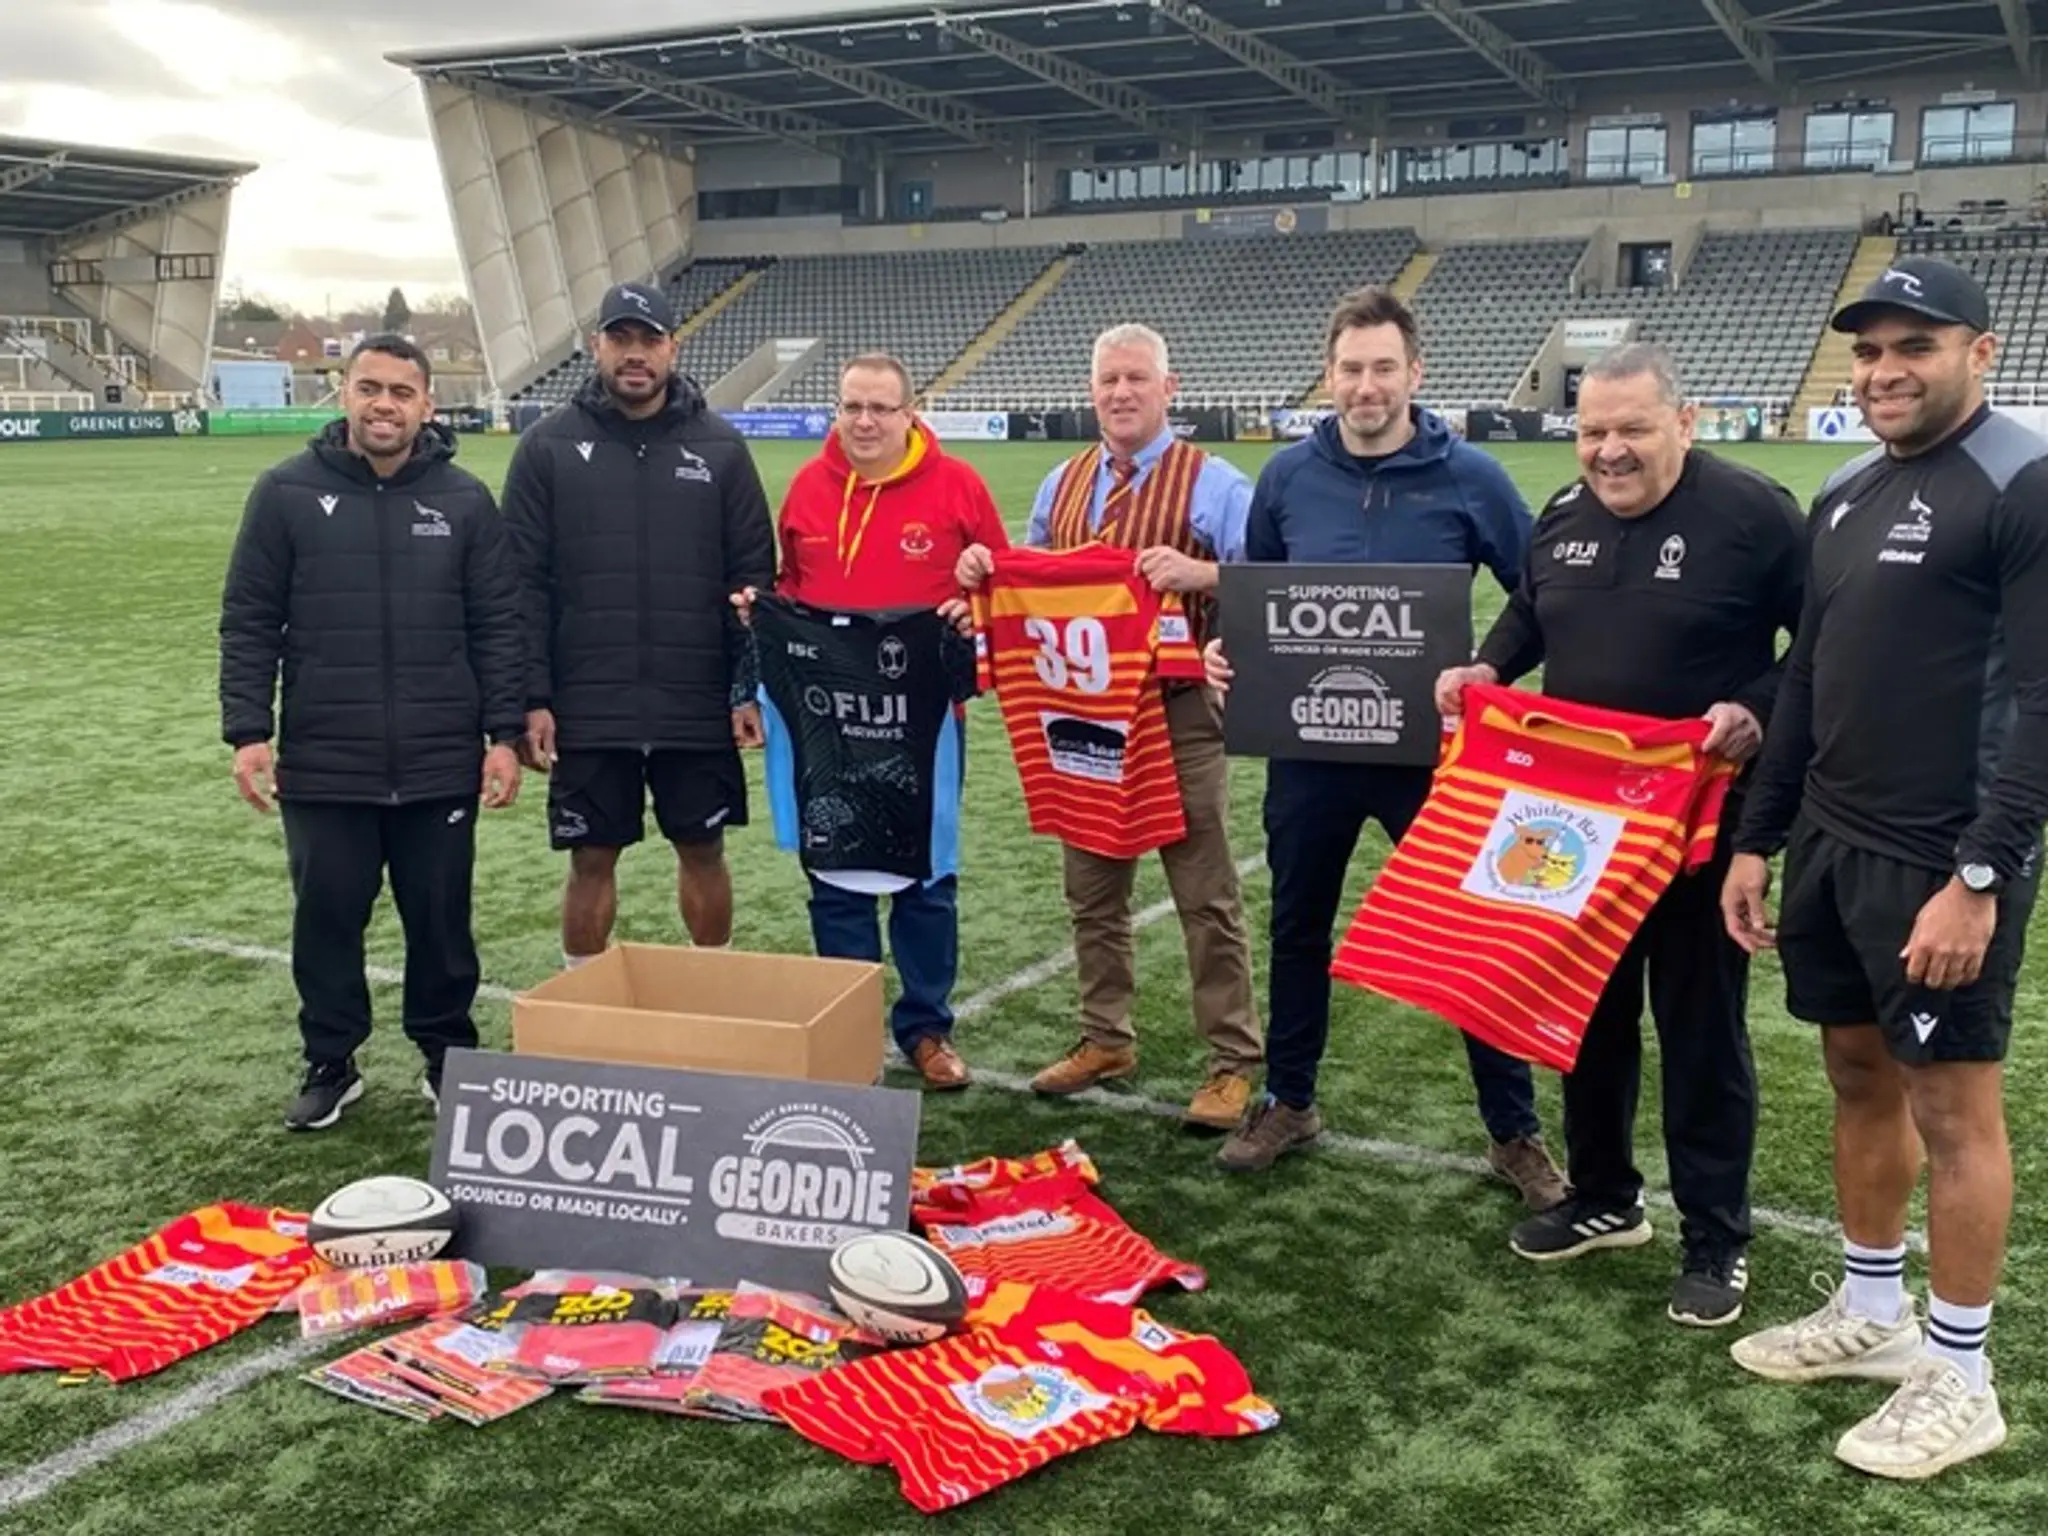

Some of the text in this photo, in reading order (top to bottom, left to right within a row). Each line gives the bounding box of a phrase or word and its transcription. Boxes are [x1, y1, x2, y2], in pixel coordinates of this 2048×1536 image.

[69, 415, 165, 432] GREENE KING
[1288, 585, 1400, 600] SUPPORTING
[1266, 602, 1425, 638] LOCAL
[1024, 616, 1112, 692] 39
[832, 691, 908, 724] FIJI
[1291, 695, 1404, 728] GEORDIE
[490, 1077, 666, 1118] SUPPORTING
[449, 1103, 694, 1193] LOCAL
[452, 1184, 681, 1226] SOURCED OR MADE LOCALLY
[708, 1154, 894, 1226] GEORDIE
[755, 1220, 838, 1245] BAKERS
[323, 1238, 439, 1269] GILBERT
[551, 1309, 629, 1325] SPORT
[554, 1288, 634, 1316] ZOO
